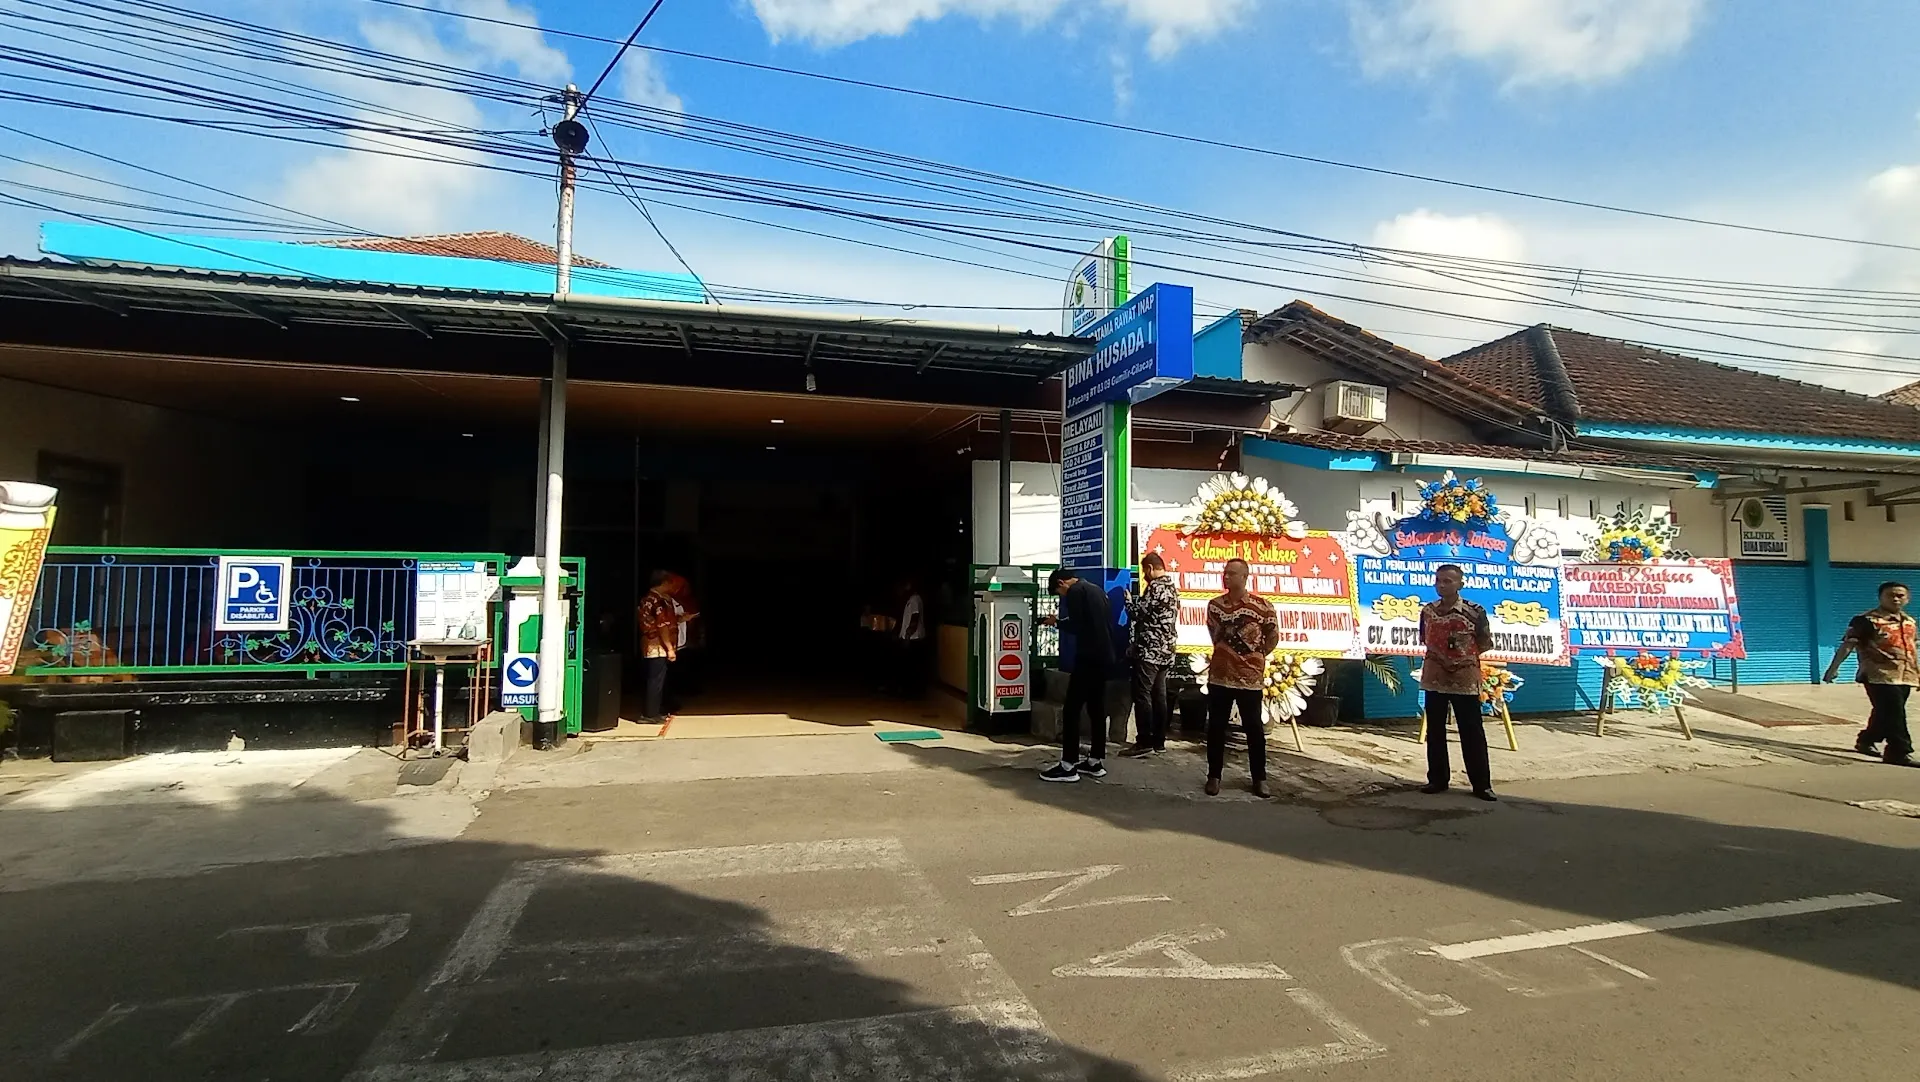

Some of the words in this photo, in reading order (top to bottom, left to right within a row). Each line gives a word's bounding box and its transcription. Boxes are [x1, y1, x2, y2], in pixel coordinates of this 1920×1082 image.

[1114, 306, 1136, 331] RAWAT
[1137, 293, 1155, 318] INAP
[1068, 359, 1094, 389] BINA
[1096, 331, 1145, 374] HUSADA
[1148, 320, 1153, 345] I
[1064, 411, 1102, 440] MELAYANI
[1074, 456, 1081, 466] 24
[1081, 452, 1092, 464] JAM
[1743, 531, 1775, 540] KLINIK
[1191, 537, 1239, 560] Selamat
[1242, 540, 1254, 562] &
[1256, 540, 1299, 564] Sukses
[1363, 559, 1382, 570] ATAS
[229, 566, 260, 599] P
[1364, 571, 1405, 586] KLINIK
[1409, 572, 1437, 587] BINA
[1492, 577, 1499, 591] 1
[1501, 578, 1552, 593] CILACAP
[1641, 567, 1694, 584] Sukses
[1589, 582, 1667, 595] AKREDITASI
[229, 612, 275, 620] DISABILITAS
[1280, 610, 1300, 629] INAP
[1301, 611, 1320, 630] DWI
[1320, 612, 1352, 632] BHAKTI
[1367, 625, 1387, 645] CV.
[1641, 631, 1690, 648] CILACAP
[996, 686, 1024, 697] KELUAR
